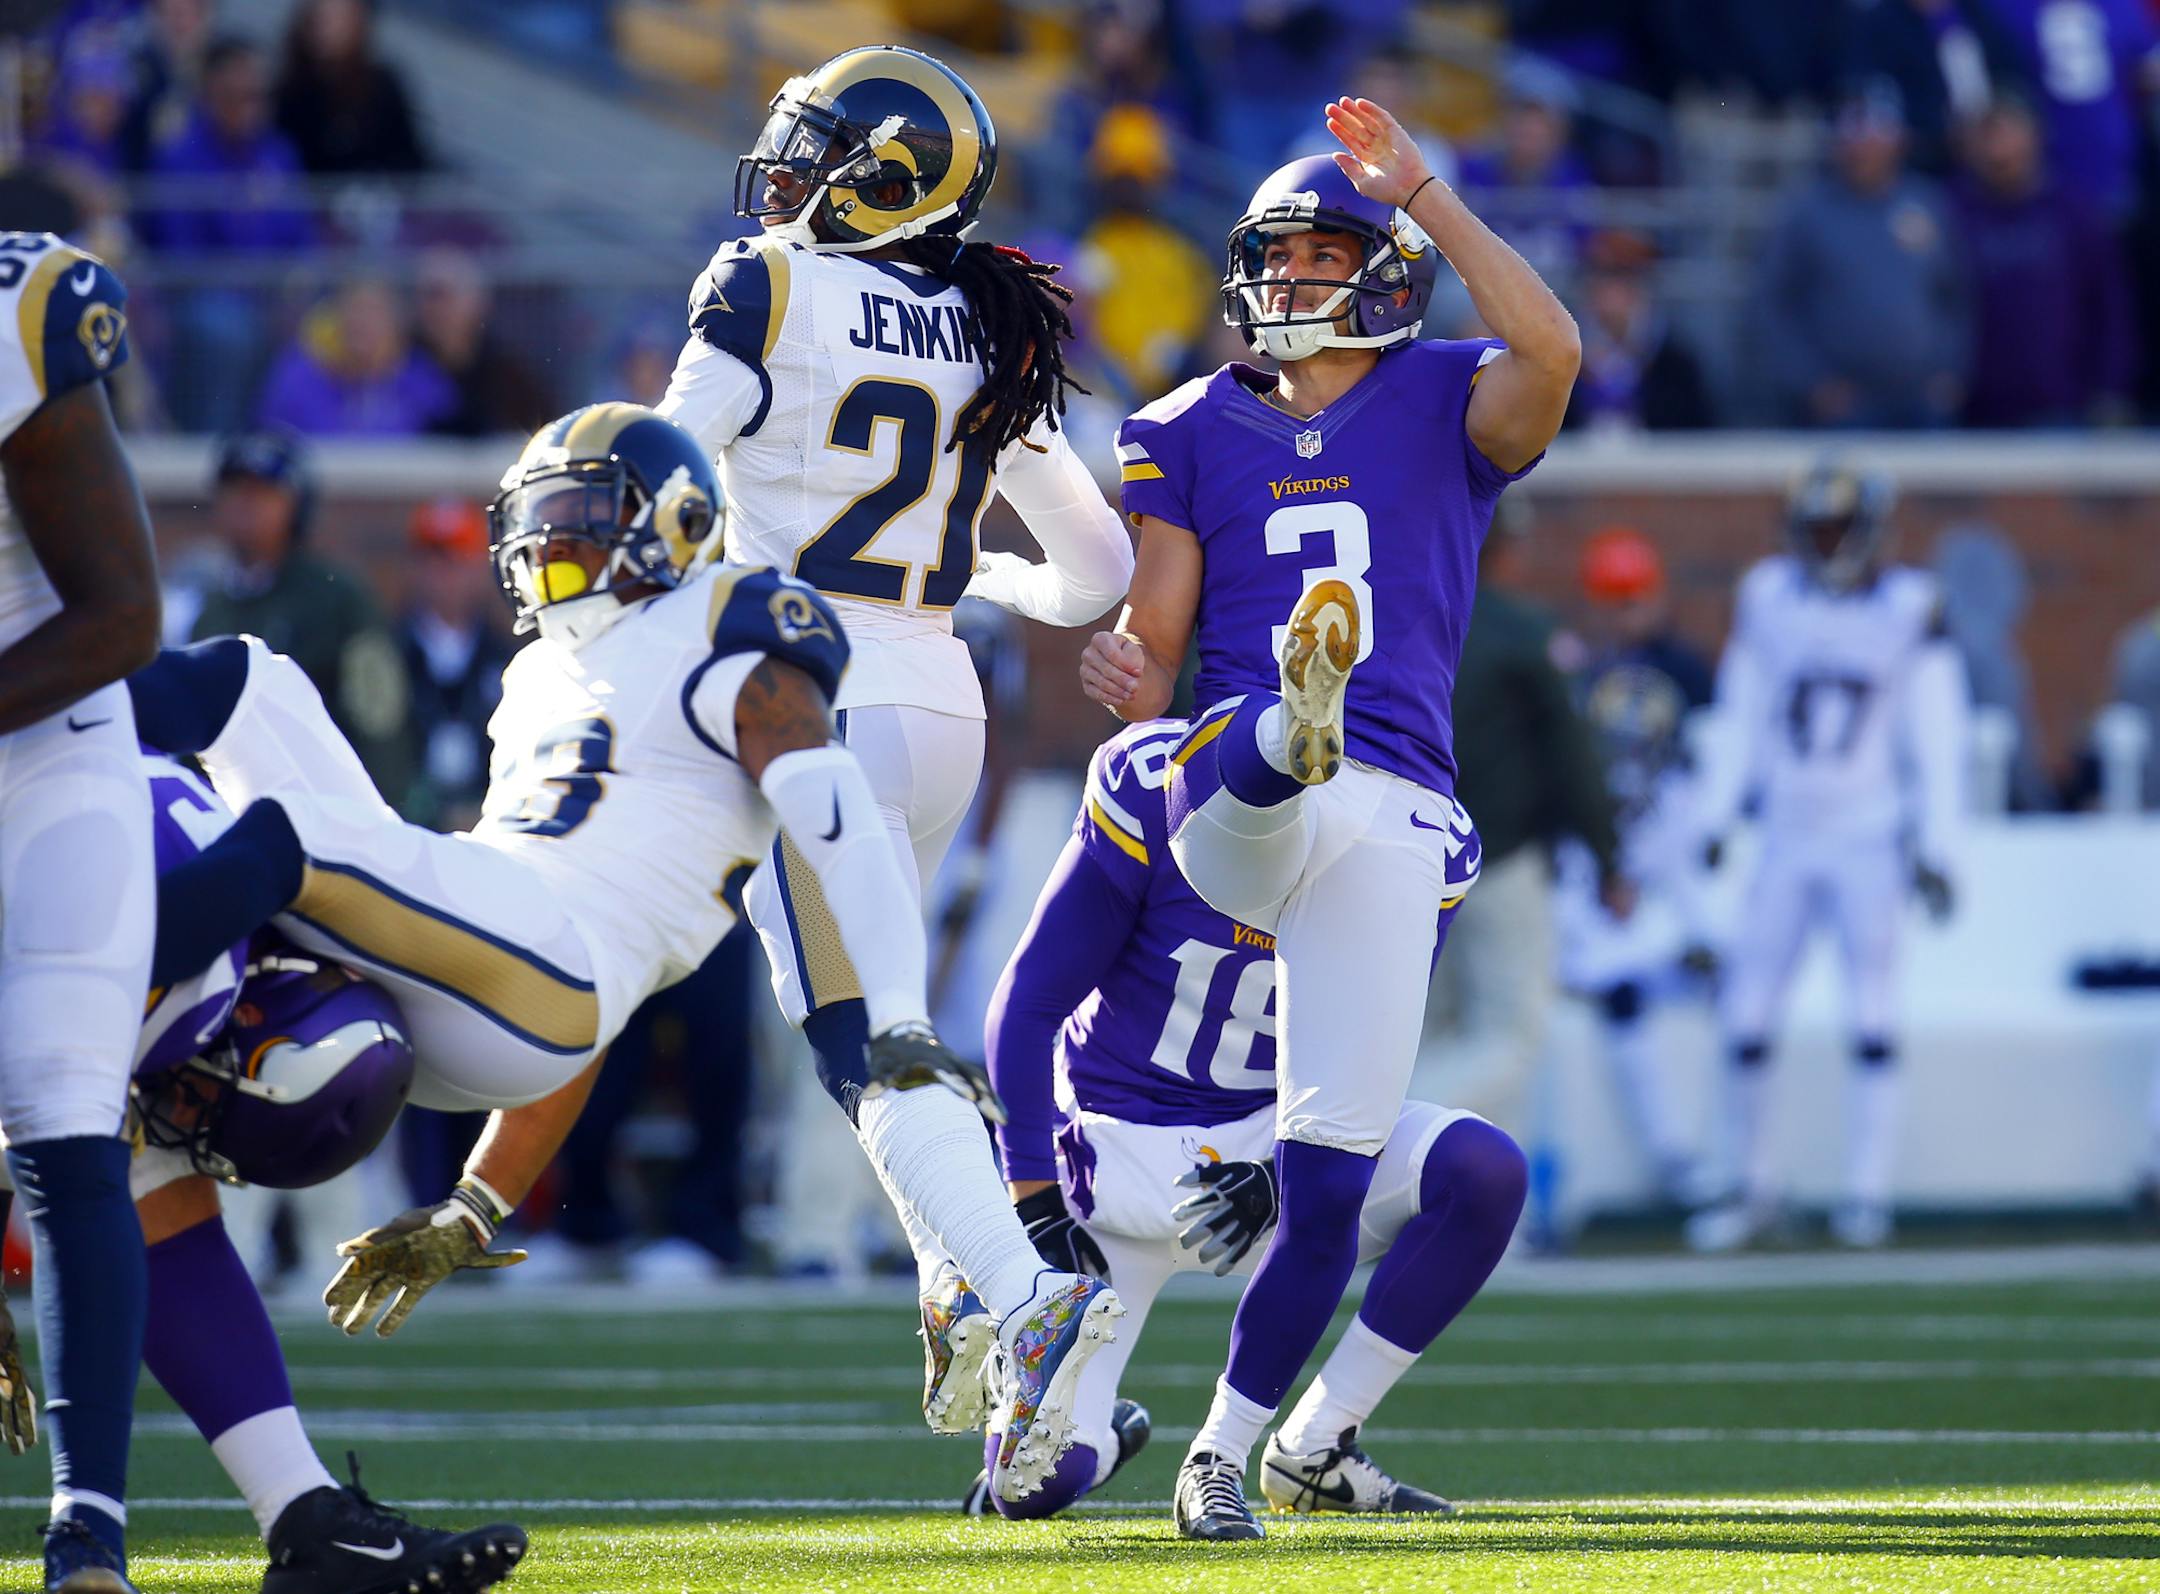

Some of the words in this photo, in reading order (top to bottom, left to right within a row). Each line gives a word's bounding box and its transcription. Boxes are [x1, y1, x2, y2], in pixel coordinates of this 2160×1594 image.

[792, 374, 998, 612] 21
[1264, 501, 1375, 669] 3
[1150, 937, 1277, 1090] 18
